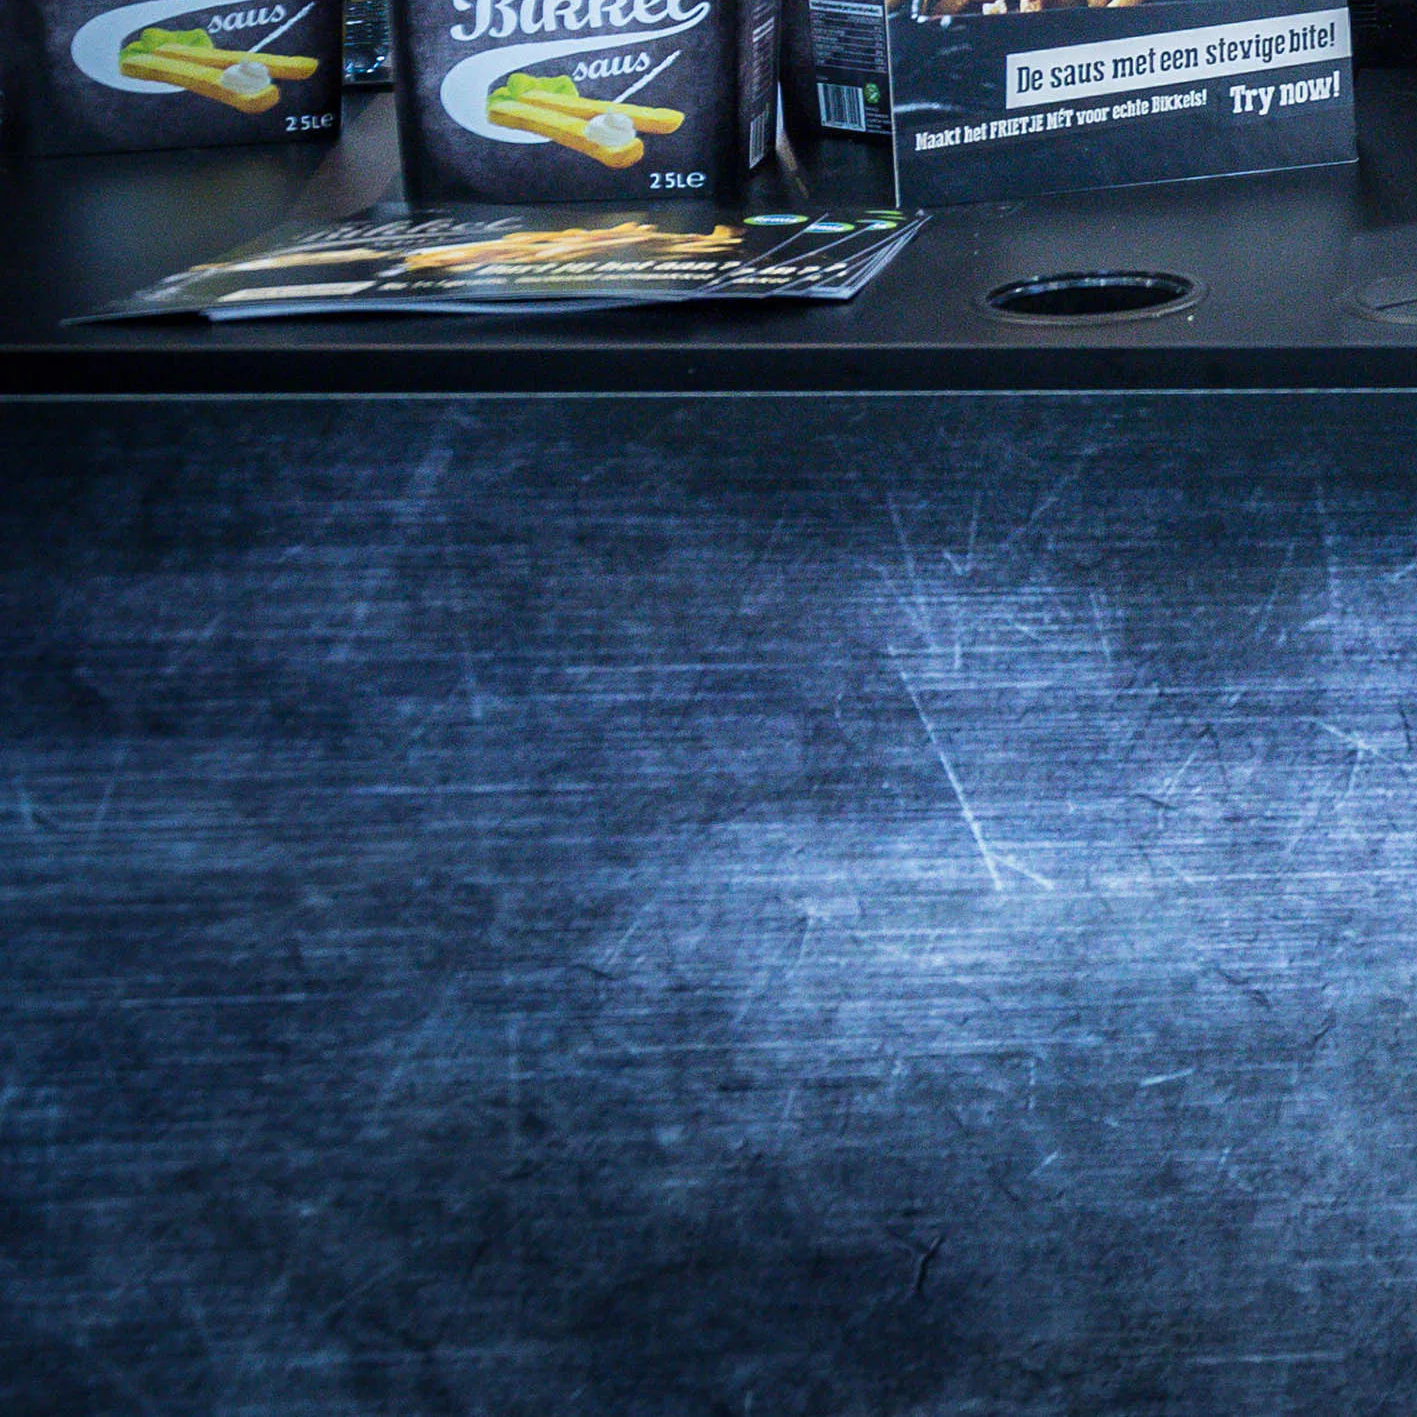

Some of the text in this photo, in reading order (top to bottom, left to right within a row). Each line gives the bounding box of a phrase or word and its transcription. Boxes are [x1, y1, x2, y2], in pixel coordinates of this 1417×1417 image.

[207, 3, 288, 34] saus
[572, 50, 651, 82] saus
[1015, 22, 1337, 94] De saus met een stevige bite!
[1229, 70, 1341, 117] Try now!
[915, 127, 962, 152] Maakt
[963, 122, 988, 145] het
[989, 114, 1045, 140] FRIETJE
[1075, 105, 1109, 126] voor
[1111, 100, 1150, 121] echte
[1151, 89, 1207, 115] Bikkels!
